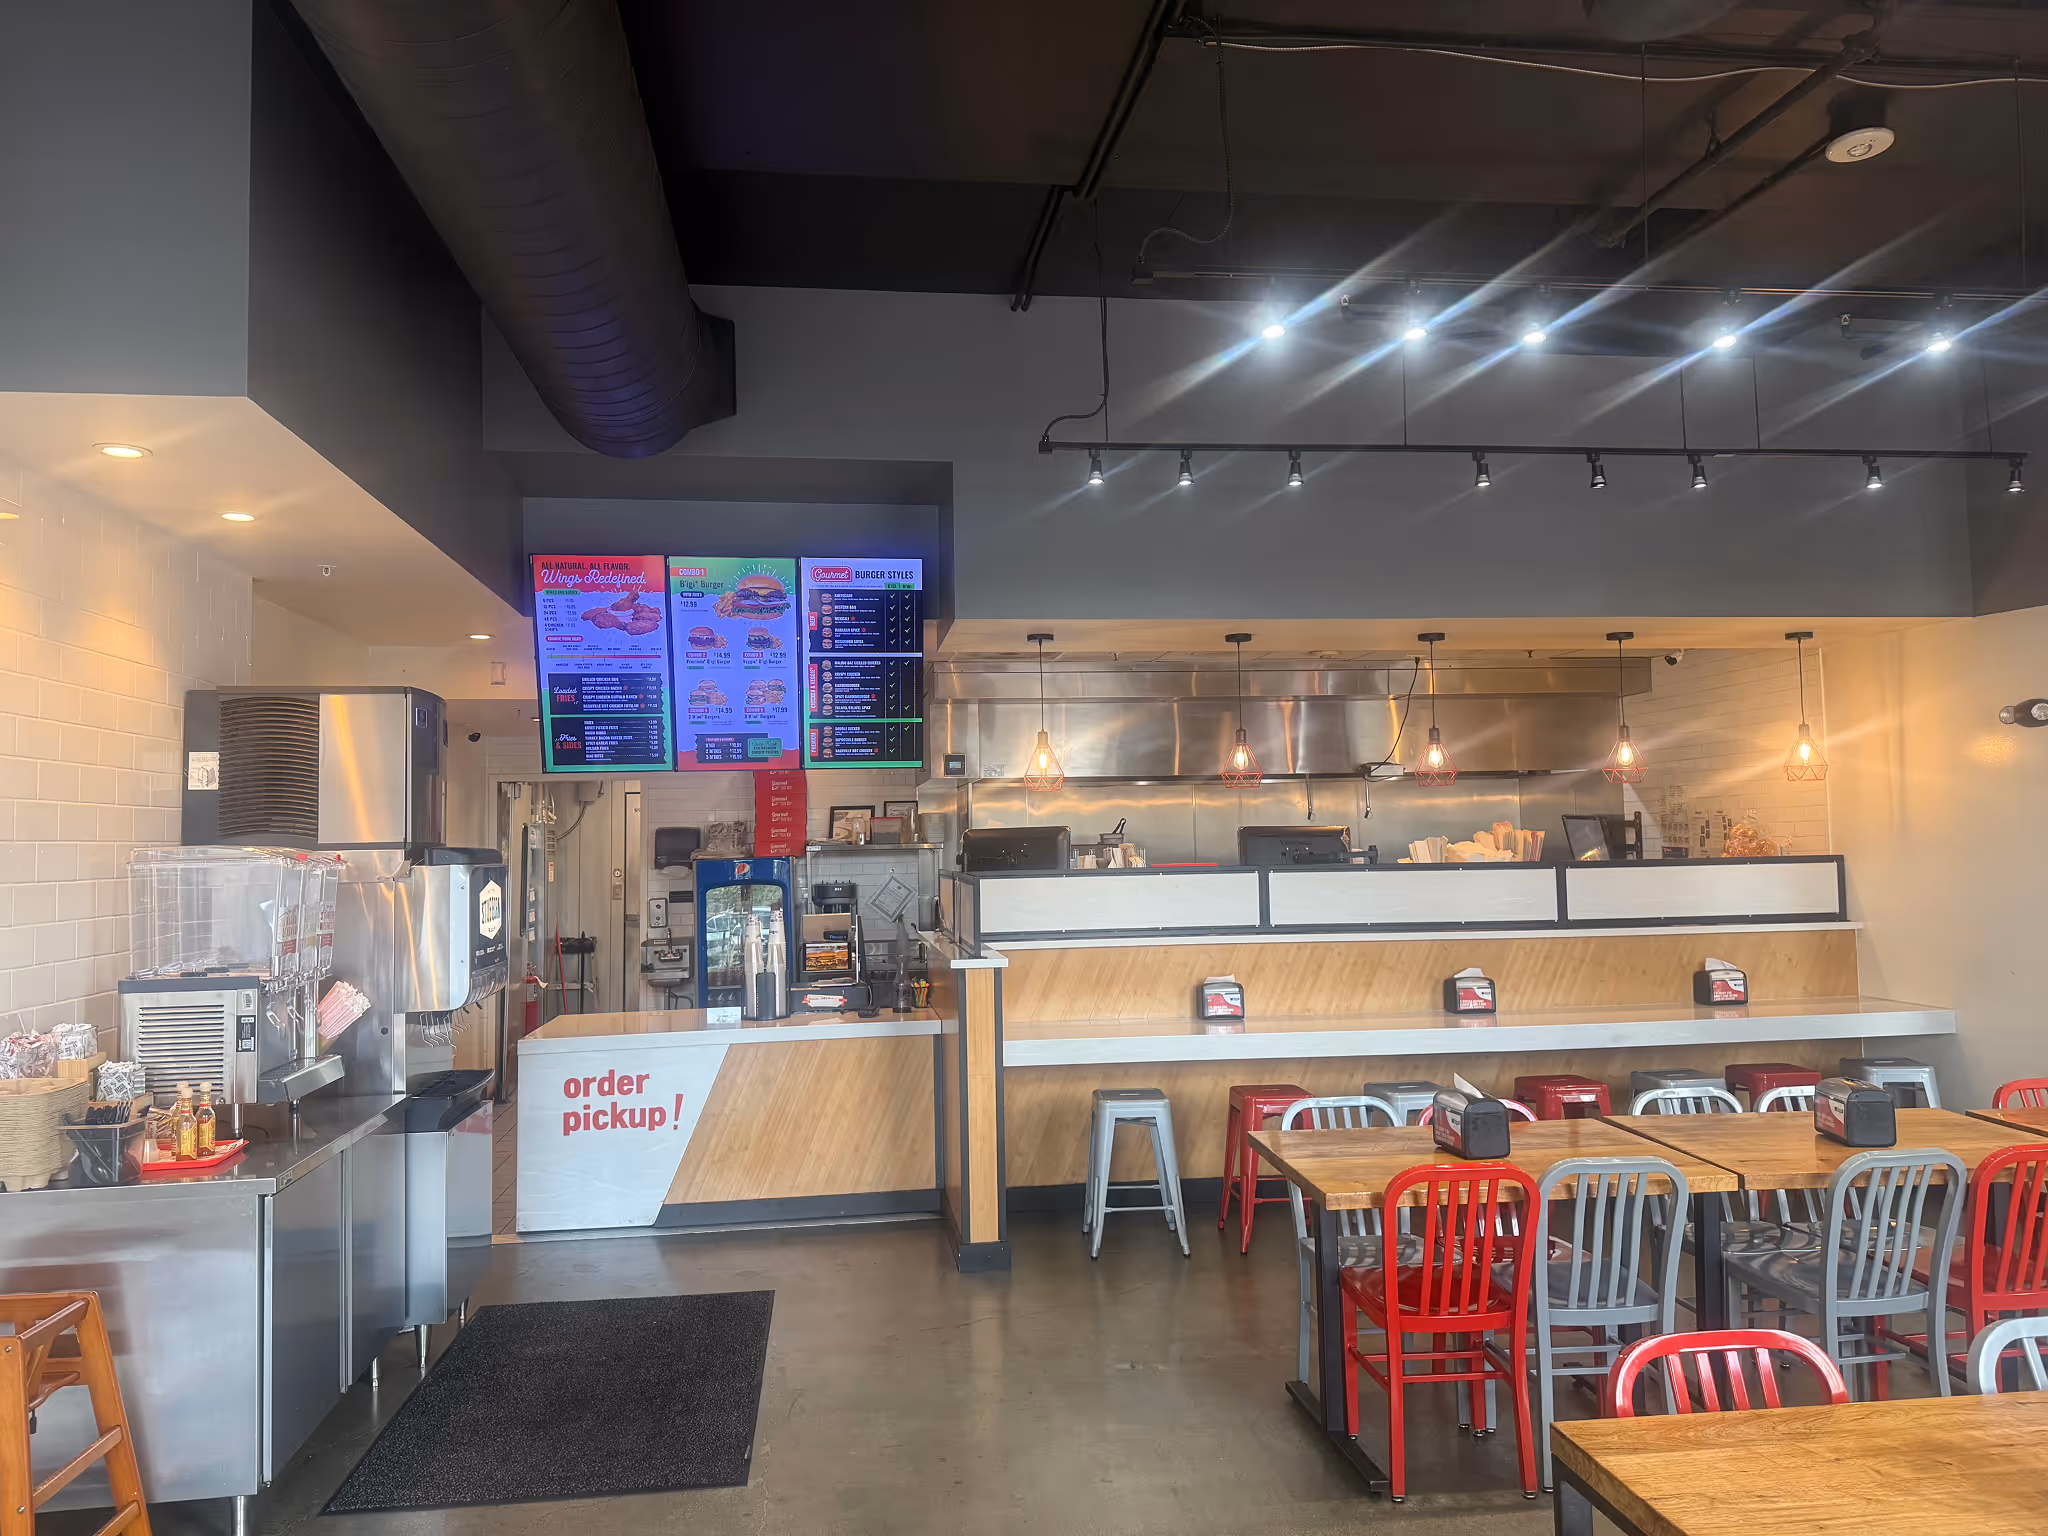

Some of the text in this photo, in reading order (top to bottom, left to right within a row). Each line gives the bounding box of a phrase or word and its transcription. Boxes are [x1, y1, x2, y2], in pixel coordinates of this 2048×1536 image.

[541, 562, 554, 570] ALL
[541, 569, 582, 587] Wings
[814, 569, 849, 582] Gourmet
[855, 571, 914, 579] BURGER STYLES
[700, 581, 724, 589] Burger
[553, 686, 577, 694] Loaded
[556, 742, 561, 750] &
[564, 1069, 650, 1098] order
